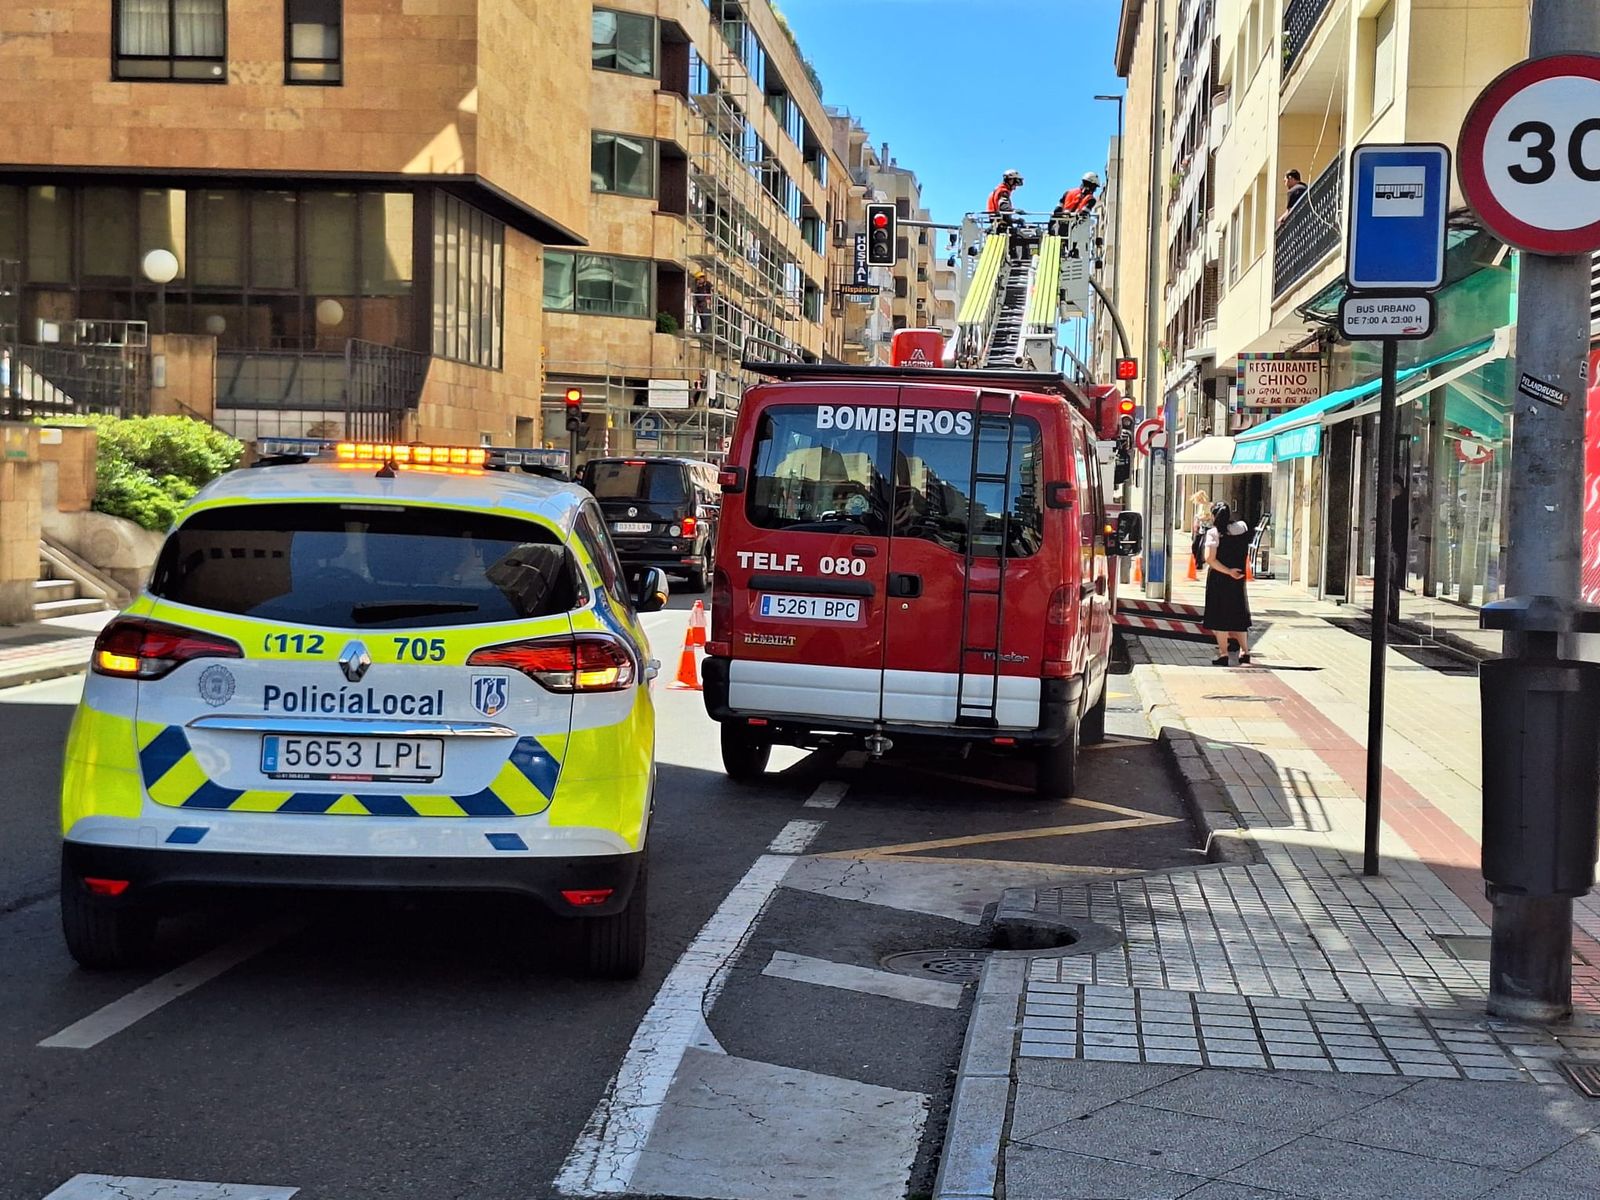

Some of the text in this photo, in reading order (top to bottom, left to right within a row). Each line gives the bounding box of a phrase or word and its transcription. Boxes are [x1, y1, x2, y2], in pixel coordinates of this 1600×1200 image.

[1507, 118, 1600, 185] 30
[857, 235, 867, 283] HOSTAL
[1356, 304, 1416, 314] BUS URBANO
[1347, 315, 1422, 325] DE 7:00 A 23:00 H
[900, 360, 934, 368] MAGIRUS
[1249, 362, 1318, 373] RESTAURANTE
[1258, 374, 1308, 386] CHINO
[816, 405, 973, 436] BOMBEROS
[736, 551, 867, 576] TELF. 080
[777, 598, 856, 618] 5261 BPC
[274, 633, 325, 654] 112
[393, 637, 446, 661] 705
[744, 632, 797, 646] RENAULT
[285, 739, 432, 770] 5653 LPL
